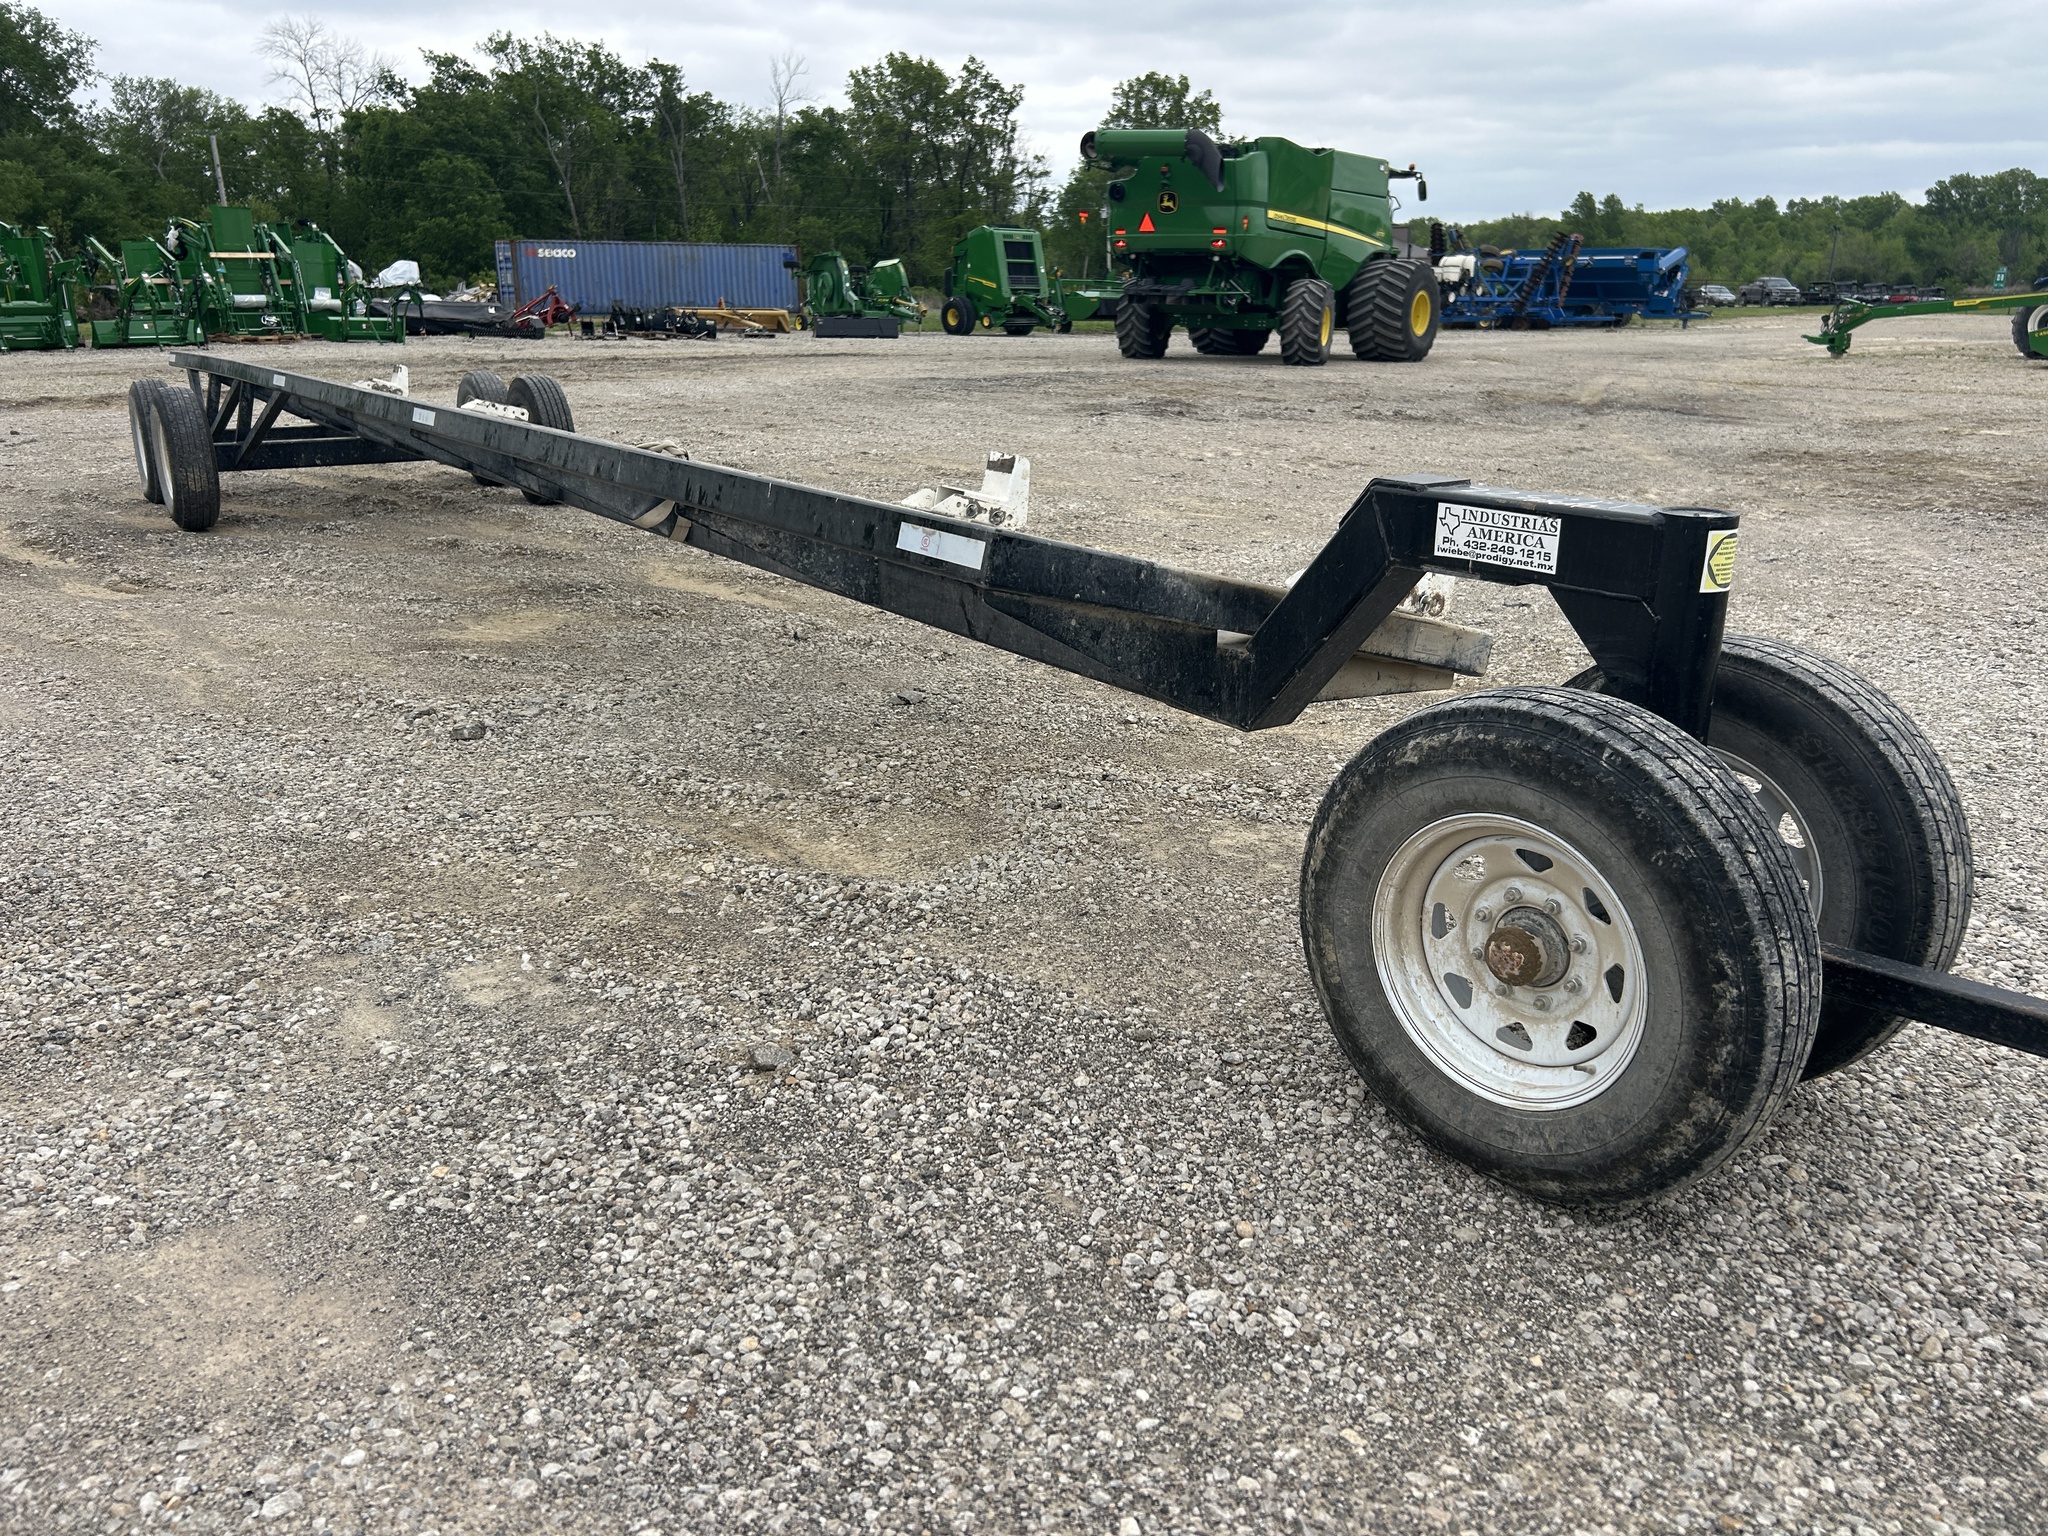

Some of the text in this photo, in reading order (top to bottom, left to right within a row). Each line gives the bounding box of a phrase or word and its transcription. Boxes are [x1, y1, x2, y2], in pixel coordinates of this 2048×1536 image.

[1462, 508, 1558, 533] INDUSTRIAS
[1442, 536, 1459, 547] Ph.
[1466, 526, 1545, 549] AMERICA
[1437, 545, 1554, 571] iwiebe@prodigy.net.mx
